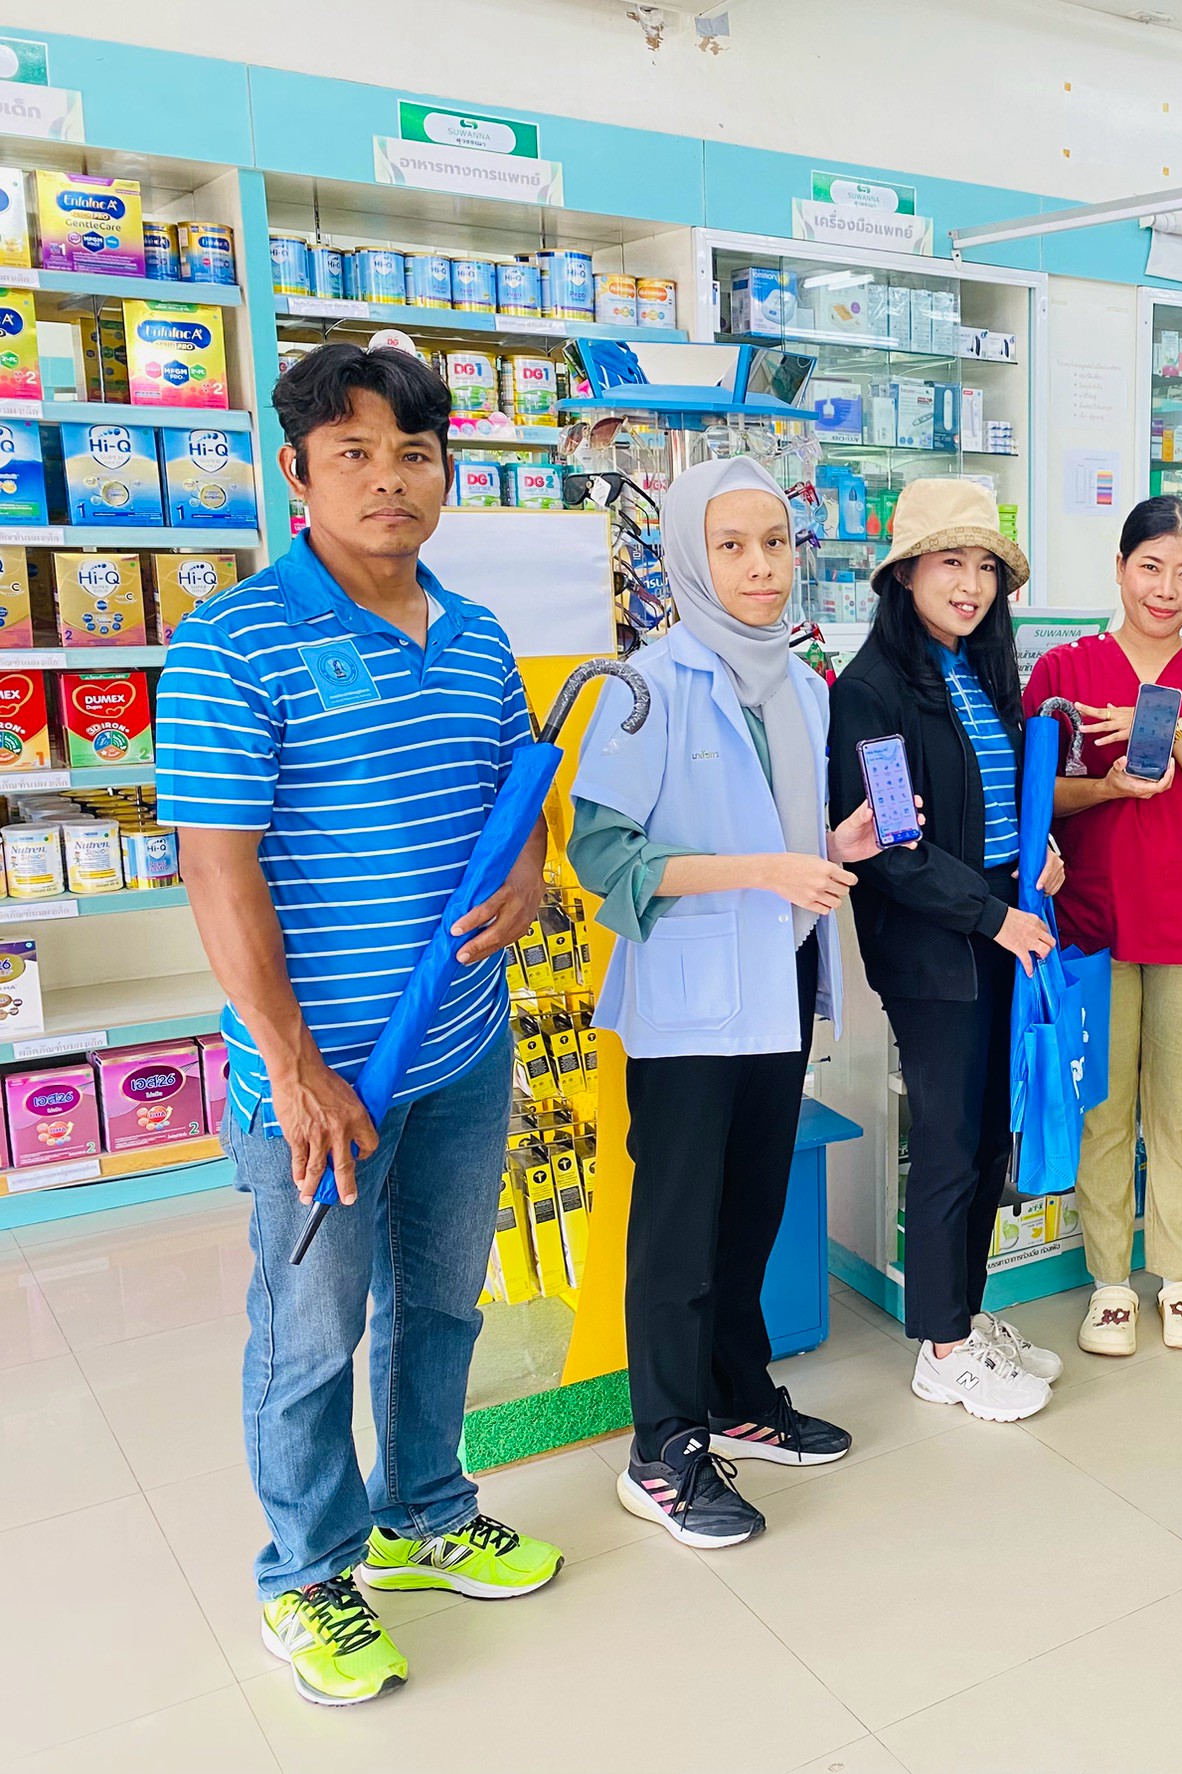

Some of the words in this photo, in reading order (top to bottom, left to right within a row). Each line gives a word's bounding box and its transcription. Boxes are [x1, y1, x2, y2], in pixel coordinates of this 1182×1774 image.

[447, 127, 491, 142] SUWANNA
[399, 156, 541, 187] อาหารทางการแพทย์
[63, 193, 107, 211] Enfalac
[847, 192, 880, 203] SUWANNA
[65, 219, 122, 232] GentleCare
[814, 209, 914, 239] เครื่องมือแพทย์
[568, 269, 586, 278] Hi-Q
[89, 438, 132, 454] Hi-Q
[189, 442, 229, 457] Hi-Q
[78, 571, 120, 585] Hi-Q
[179, 571, 217, 585] Hi-Q
[1034, 629, 1082, 637] SUWANNA
[84, 694, 126, 704] DUMEX
[86, 724, 101, 735] 3D
[36, 751, 45, 766] 1
[11, 844, 47, 854] Nutren
[75, 841, 110, 850] Nutren
[146, 844, 167, 852] Hi-Q
[130, 1072, 176, 1091] เอส26
[33, 1091, 74, 1107] เอส26
[188, 1122, 200, 1136] 2
[86, 1142, 96, 1153] 2
